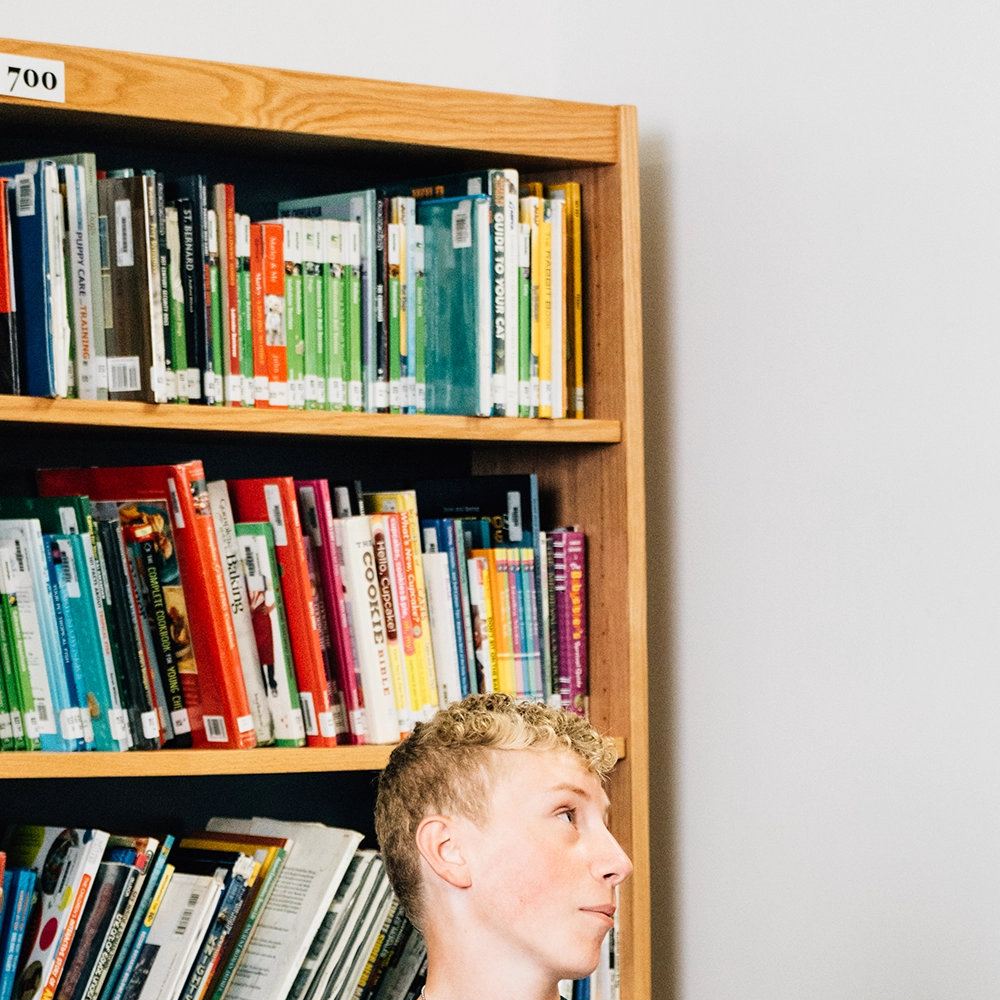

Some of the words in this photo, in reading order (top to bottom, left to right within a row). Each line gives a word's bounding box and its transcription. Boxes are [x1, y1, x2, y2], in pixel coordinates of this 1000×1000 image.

[7, 66, 57, 92] 700
[183, 209, 192, 223] ST.
[493, 212, 504, 252] GUIDE
[183, 225, 194, 271] BERNARD
[269, 237, 277, 260] Marley
[269, 271, 277, 283] Me
[494, 256, 504, 275] TO
[78, 270, 86, 296] CARE
[254, 272, 262, 295] Marley
[494, 277, 504, 313] YOUR
[80, 306, 88, 359] TRAINING
[494, 316, 505, 339] CAT
[389, 518, 400, 560] cupcakes,
[400, 512, 411, 547] What's
[405, 548, 414, 572] New,
[94, 587, 102, 608] ABOUT
[226, 554, 244, 615] Baking
[376, 541, 388, 575] Hello,
[382, 578, 397, 632] Cupcake!
[407, 574, 419, 622] Cupcake?
[147, 567, 162, 608] COMPLETE
[156, 611, 170, 652] COOKBOOK
[167, 667, 179, 693] YOUNG
[363, 551, 384, 645] COOKIE
[378, 650, 390, 696] BIBLE
[72, 889, 86, 918] CHILDREN'S
[59, 919, 76, 956] INTERACTIVE
[368, 933, 385, 963] SUPER
[49, 977, 56, 986] OF
[52, 957, 63, 977] STORY
[358, 963, 373, 987] HERO
